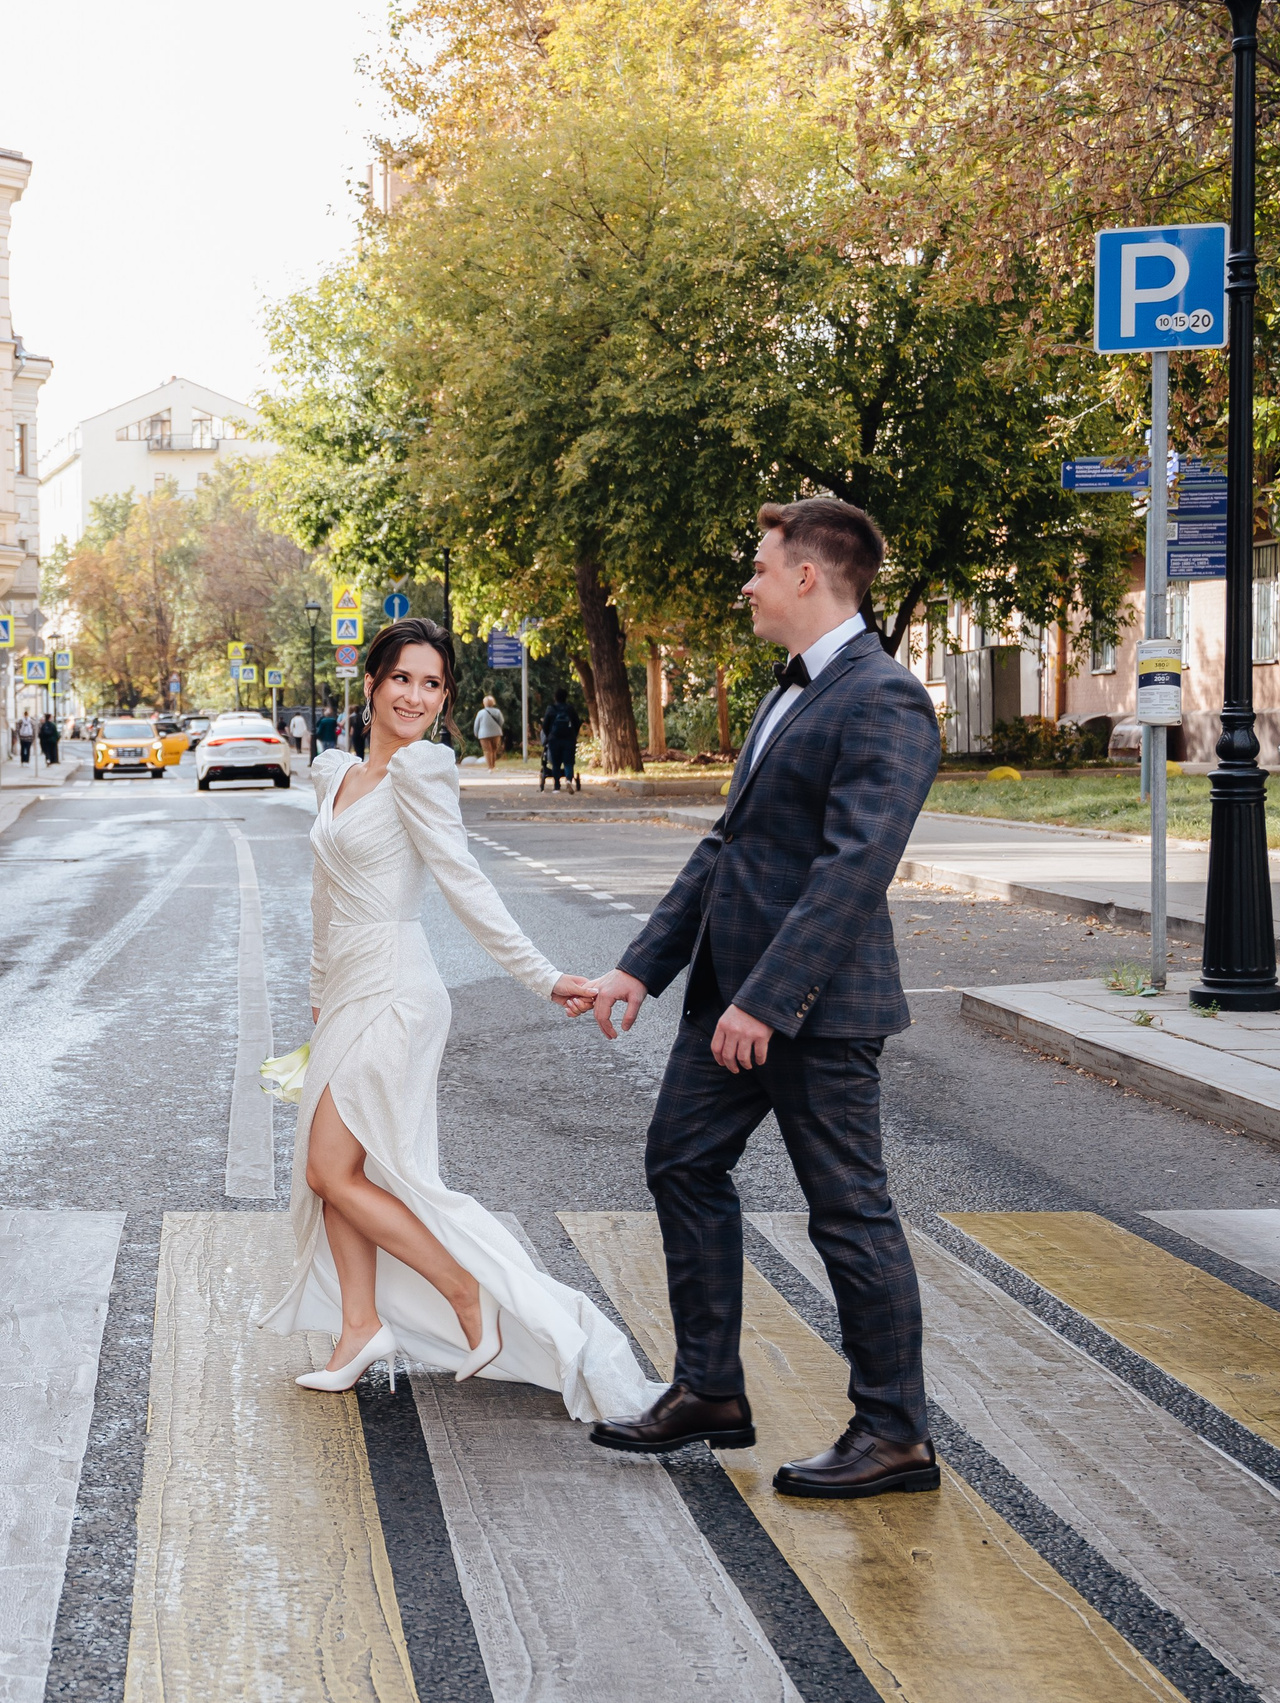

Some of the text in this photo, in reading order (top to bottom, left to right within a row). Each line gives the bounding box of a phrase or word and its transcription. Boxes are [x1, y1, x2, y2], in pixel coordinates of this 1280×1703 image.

[1120, 242, 1190, 338] P
[1160, 314, 1211, 328] 10 15 20
